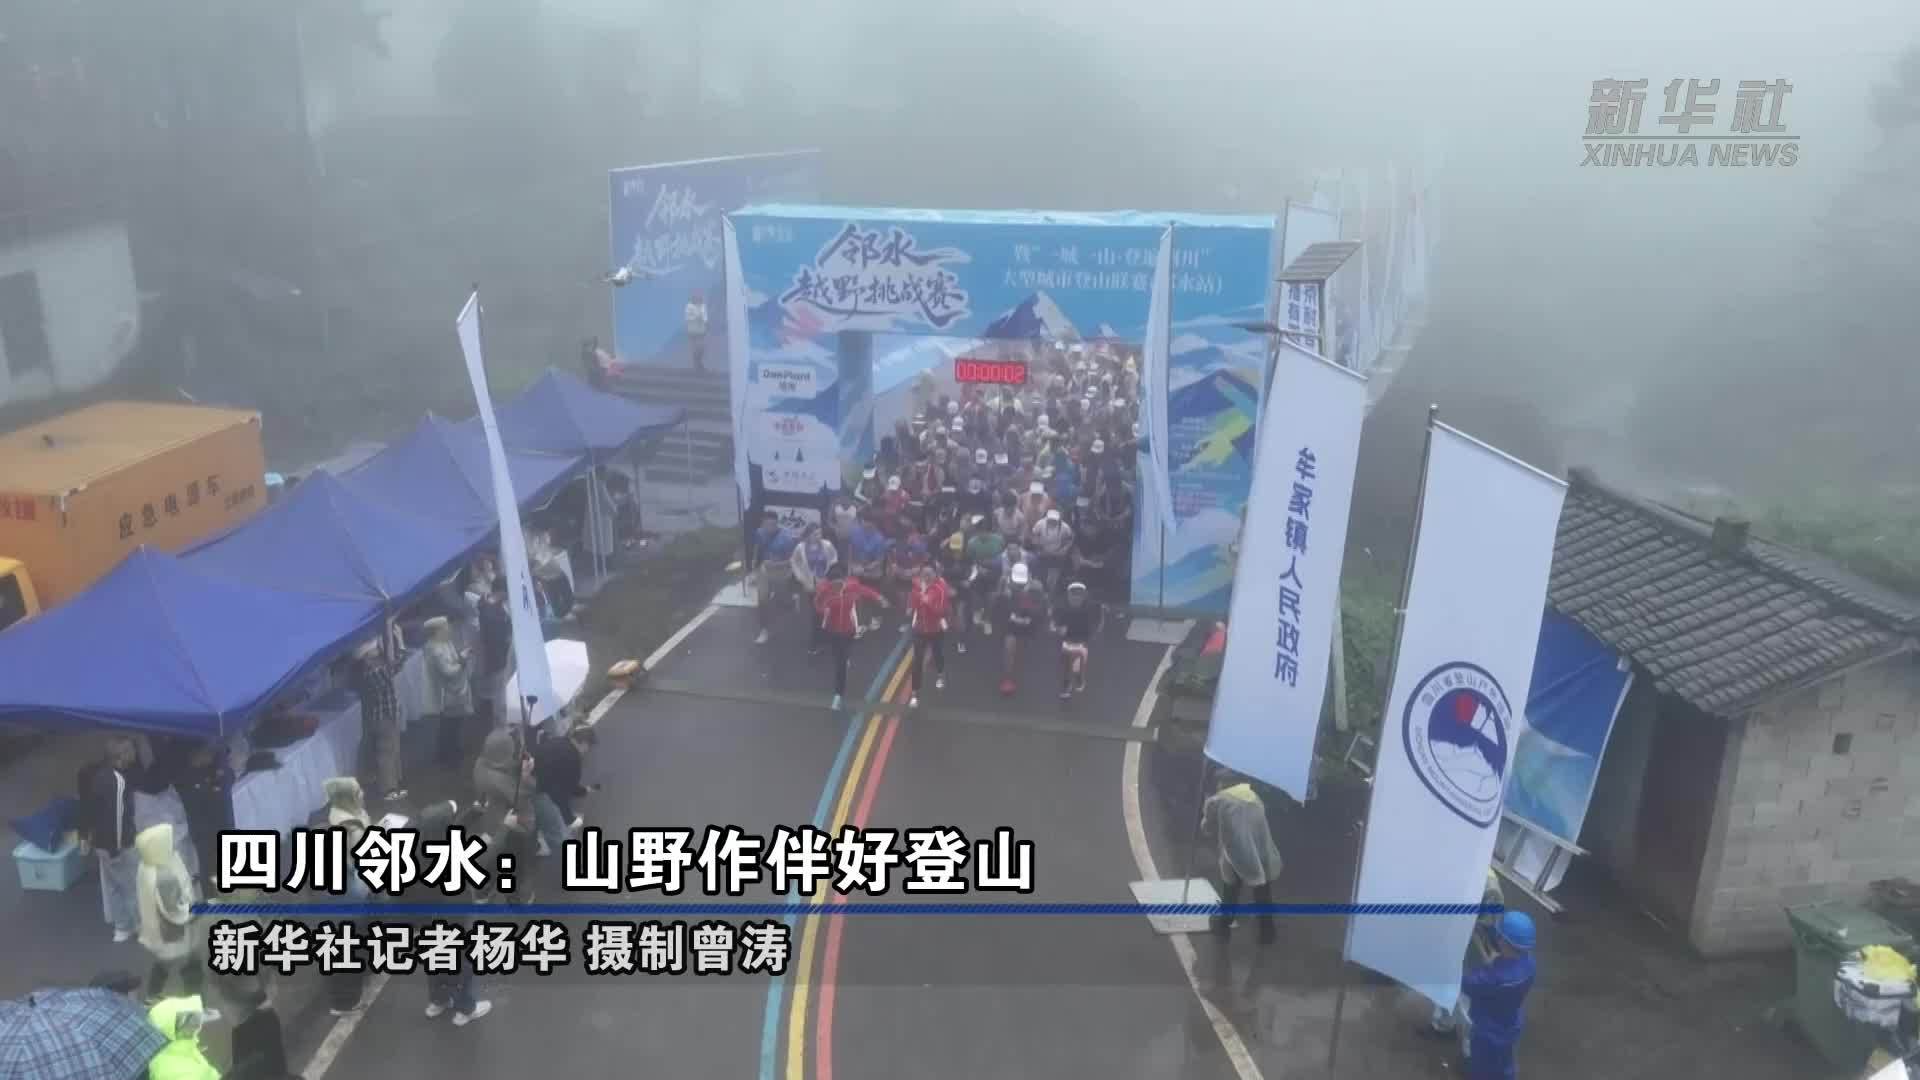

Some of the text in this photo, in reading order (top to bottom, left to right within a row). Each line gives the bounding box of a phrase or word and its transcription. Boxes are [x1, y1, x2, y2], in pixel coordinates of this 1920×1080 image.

[817, 222, 962, 268] 邻水
[780, 268, 968, 327] 越野挑战赛
[1274, 447, 1317, 688] 牟家镇人民政府
